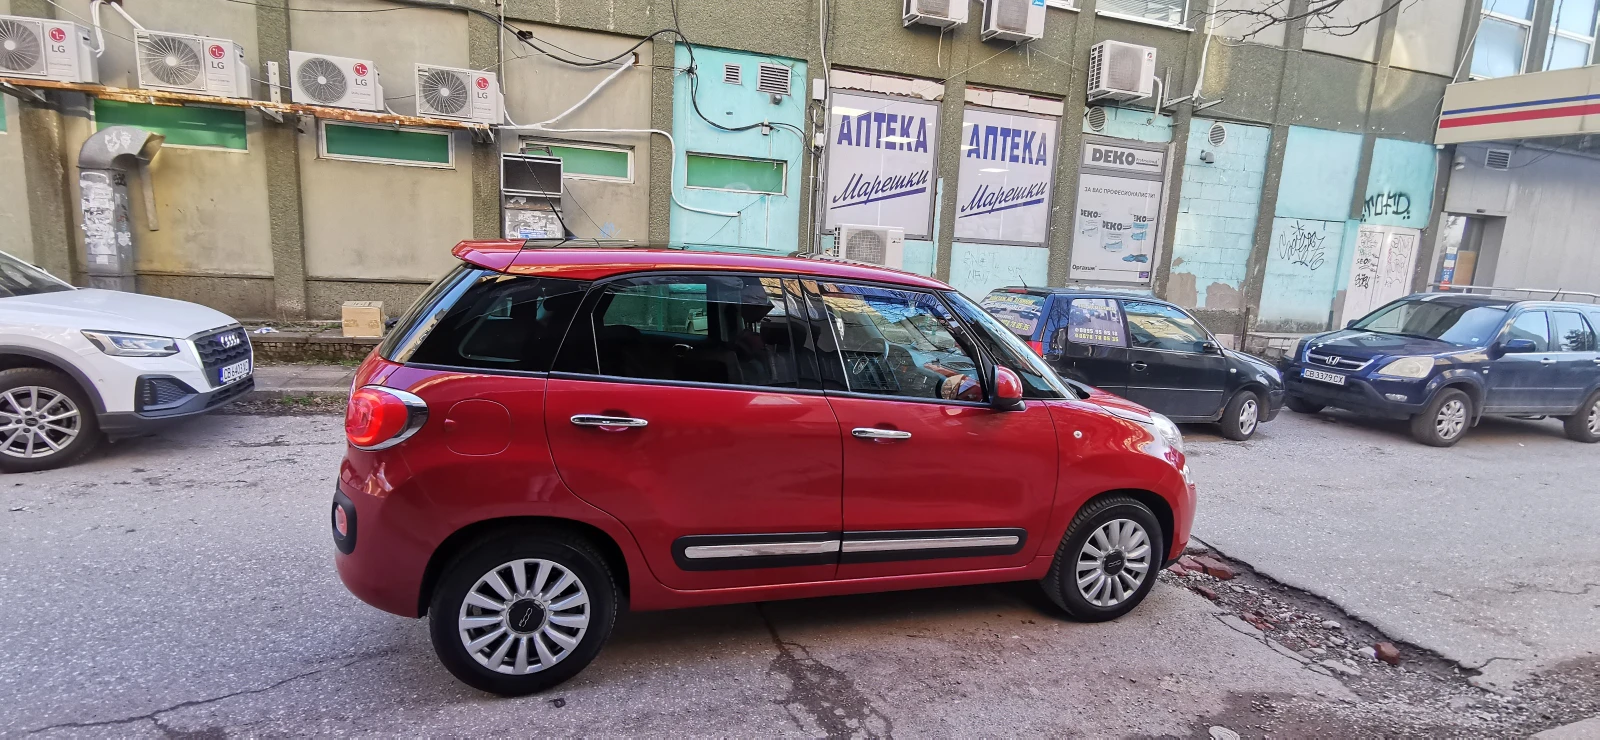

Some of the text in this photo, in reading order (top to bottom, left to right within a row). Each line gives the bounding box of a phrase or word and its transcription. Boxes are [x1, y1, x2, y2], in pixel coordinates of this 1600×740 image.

[52, 45, 65, 53] LG
[211, 61, 225, 69] LG
[355, 79, 368, 87] LG
[837, 111, 928, 153] АПТЕКА
[967, 123, 1047, 166] АПТЕКА
[1092, 148, 1135, 166] DEKO
[833, 170, 929, 204] Марешки
[961, 182, 1047, 213] Марешки
[224, 368, 230, 379] CB
[1315, 372, 1333, 381] 3379
[1333, 375, 1344, 384] CX
